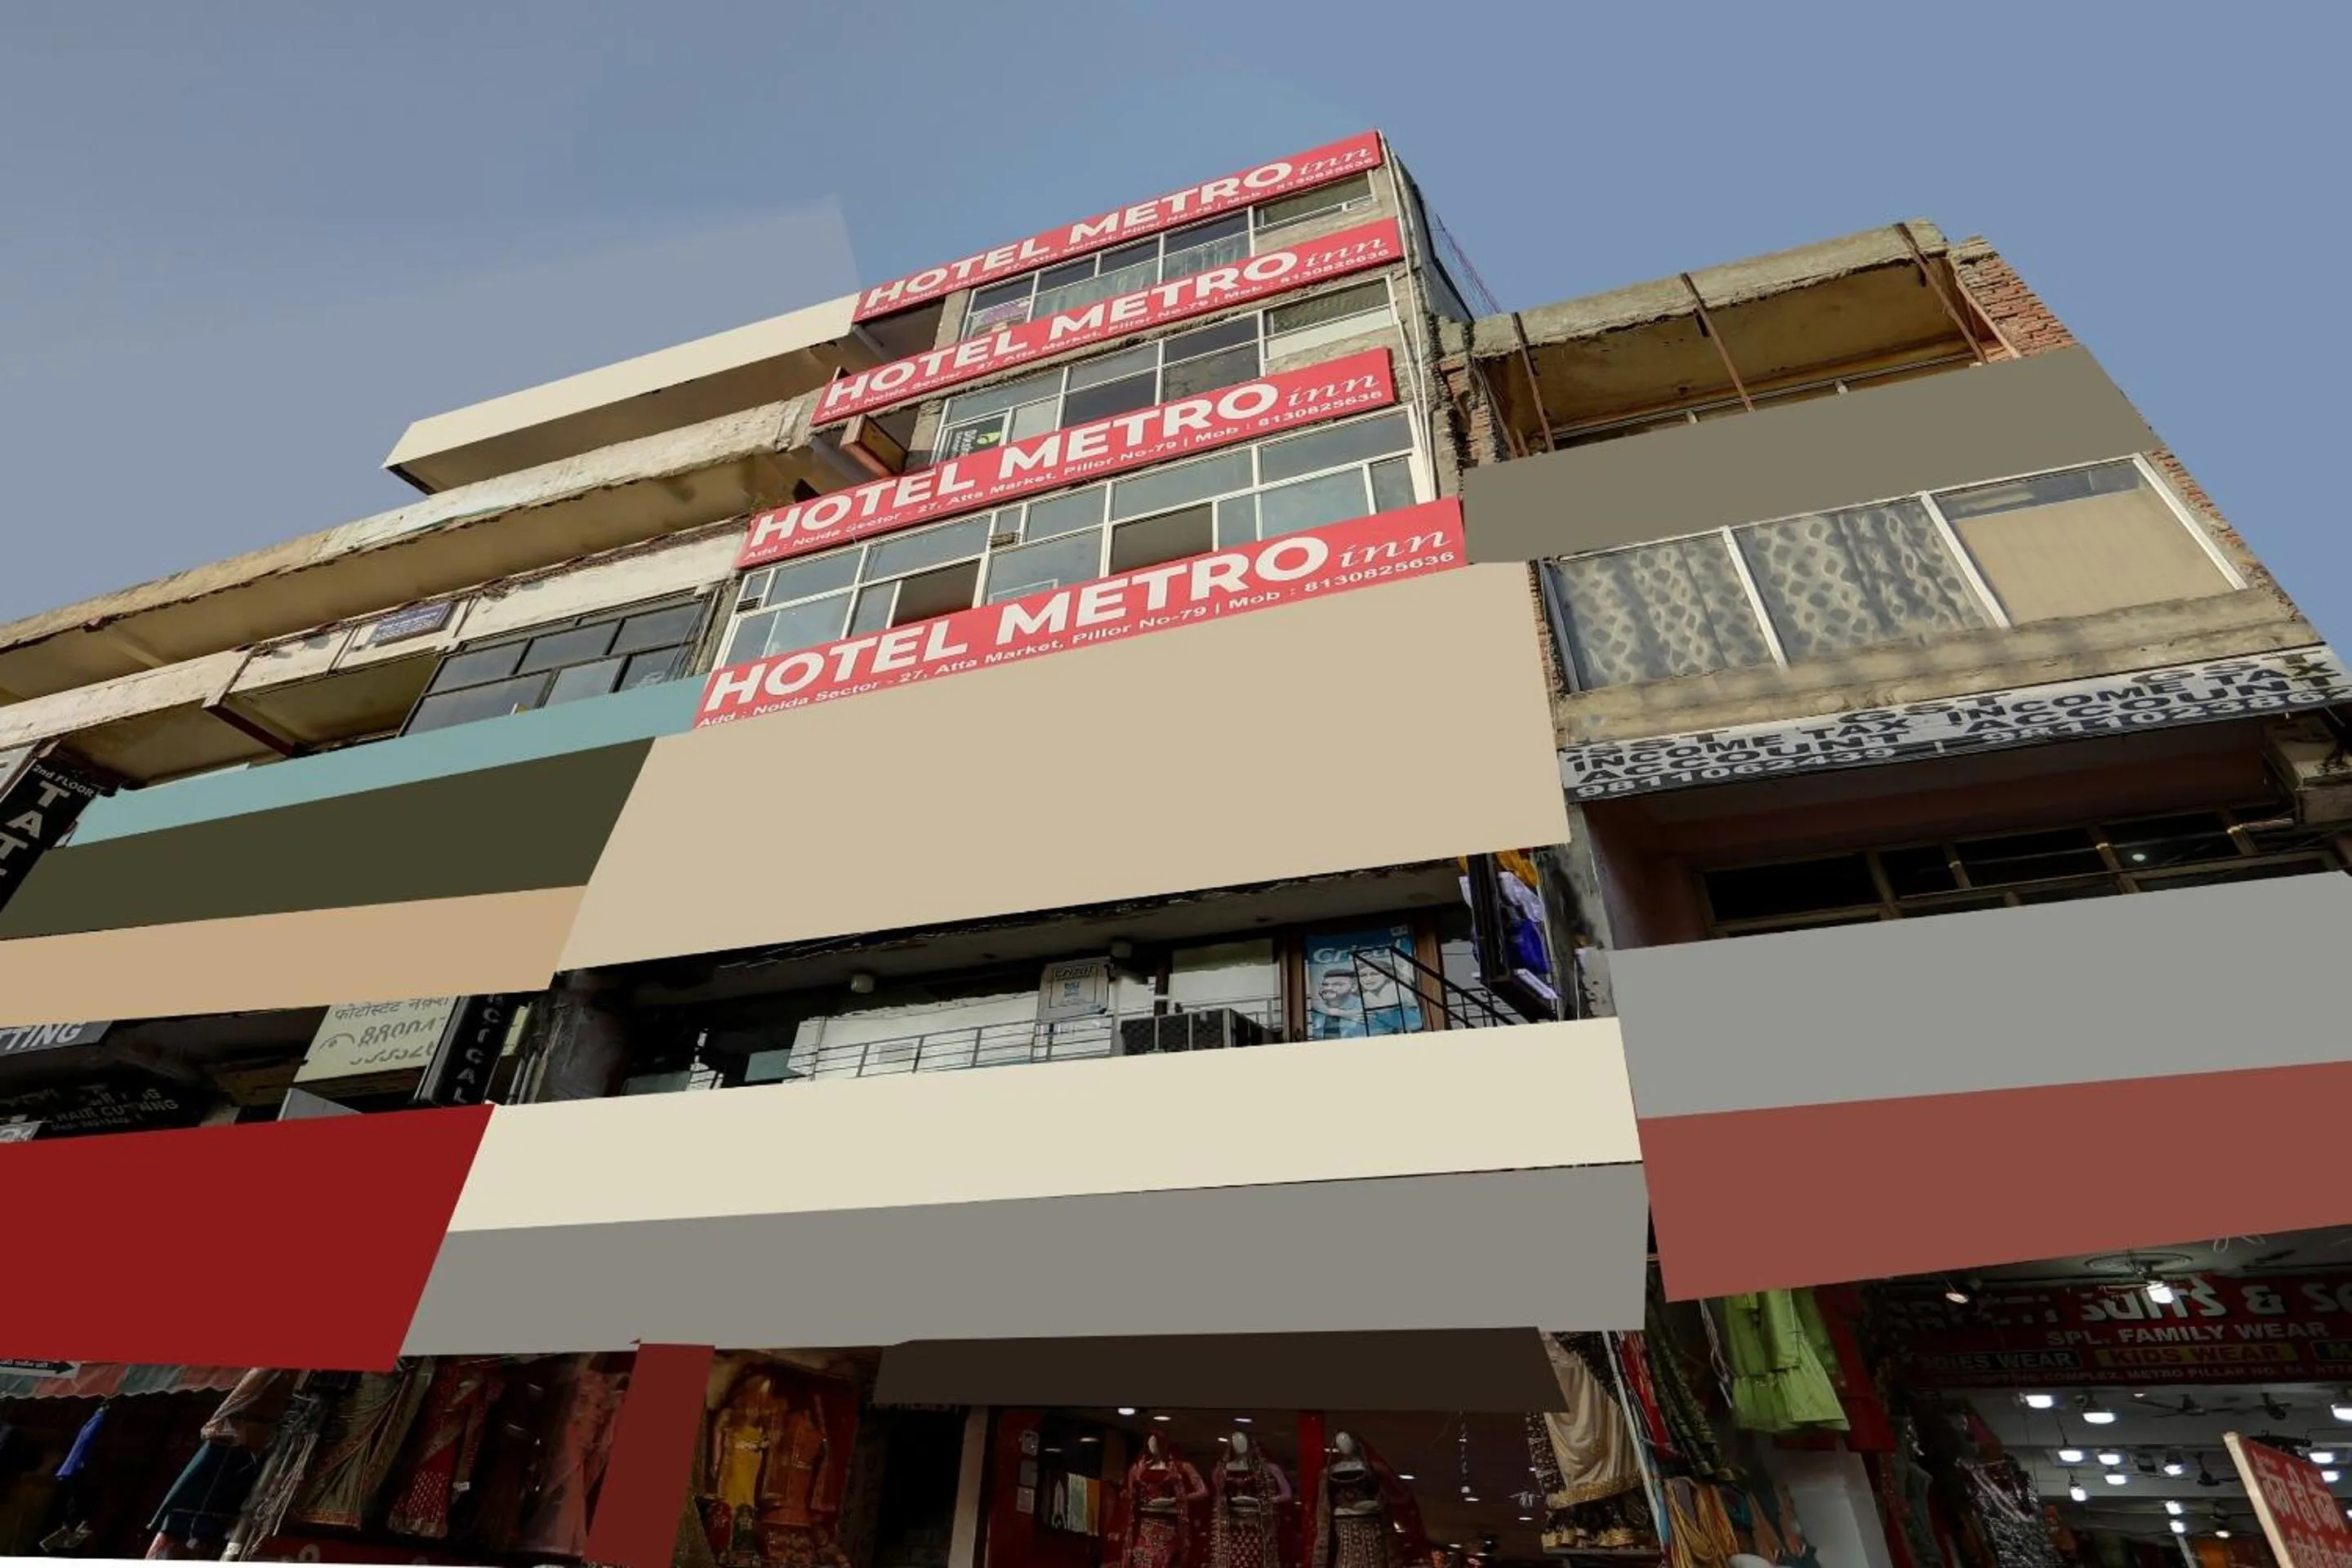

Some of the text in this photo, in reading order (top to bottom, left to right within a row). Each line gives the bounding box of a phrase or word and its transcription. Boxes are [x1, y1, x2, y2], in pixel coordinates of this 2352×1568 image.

[864, 147, 1373, 309] HOTEL METRO inn
[825, 237, 1388, 408] HOTEL METRO inn
[743, 544, 778, 561] Add
[792, 528, 841, 548] Noida
[947, 489, 984, 505] Atta
[1196, 426, 1239, 443] Mob
[1257, 390, 1383, 427] 8130825636
[751, 372, 1380, 547] HOTEL METRO inn
[697, 710, 737, 729] Add
[752, 696, 809, 717] Noida
[814, 680, 880, 702] Sector
[933, 658, 978, 675] Atta
[1139, 606, 1207, 629] No-79
[1227, 589, 1281, 609] Mob
[1304, 550, 1455, 593] 8130825636
[703, 528, 1452, 713] HOTEL METRO inn
[1947, 660, 2334, 726] INCOME TAX
[1967, 672, 2341, 733] ACCOUNT
[1572, 718, 1909, 772] INCOME TAX
[1578, 730, 1911, 787] ACCOUNT
[32, 764, 56, 779] 2nd
[55, 774, 96, 798] FLOOR
[0, 1022, 82, 1052] TING
[1997, 1352, 2076, 1368] WEAR
[2111, 1344, 2283, 1365] KIDS WEAR
[2117, 1325, 2226, 1343] FAMILY
[2234, 1321, 2331, 1340] WEAR
